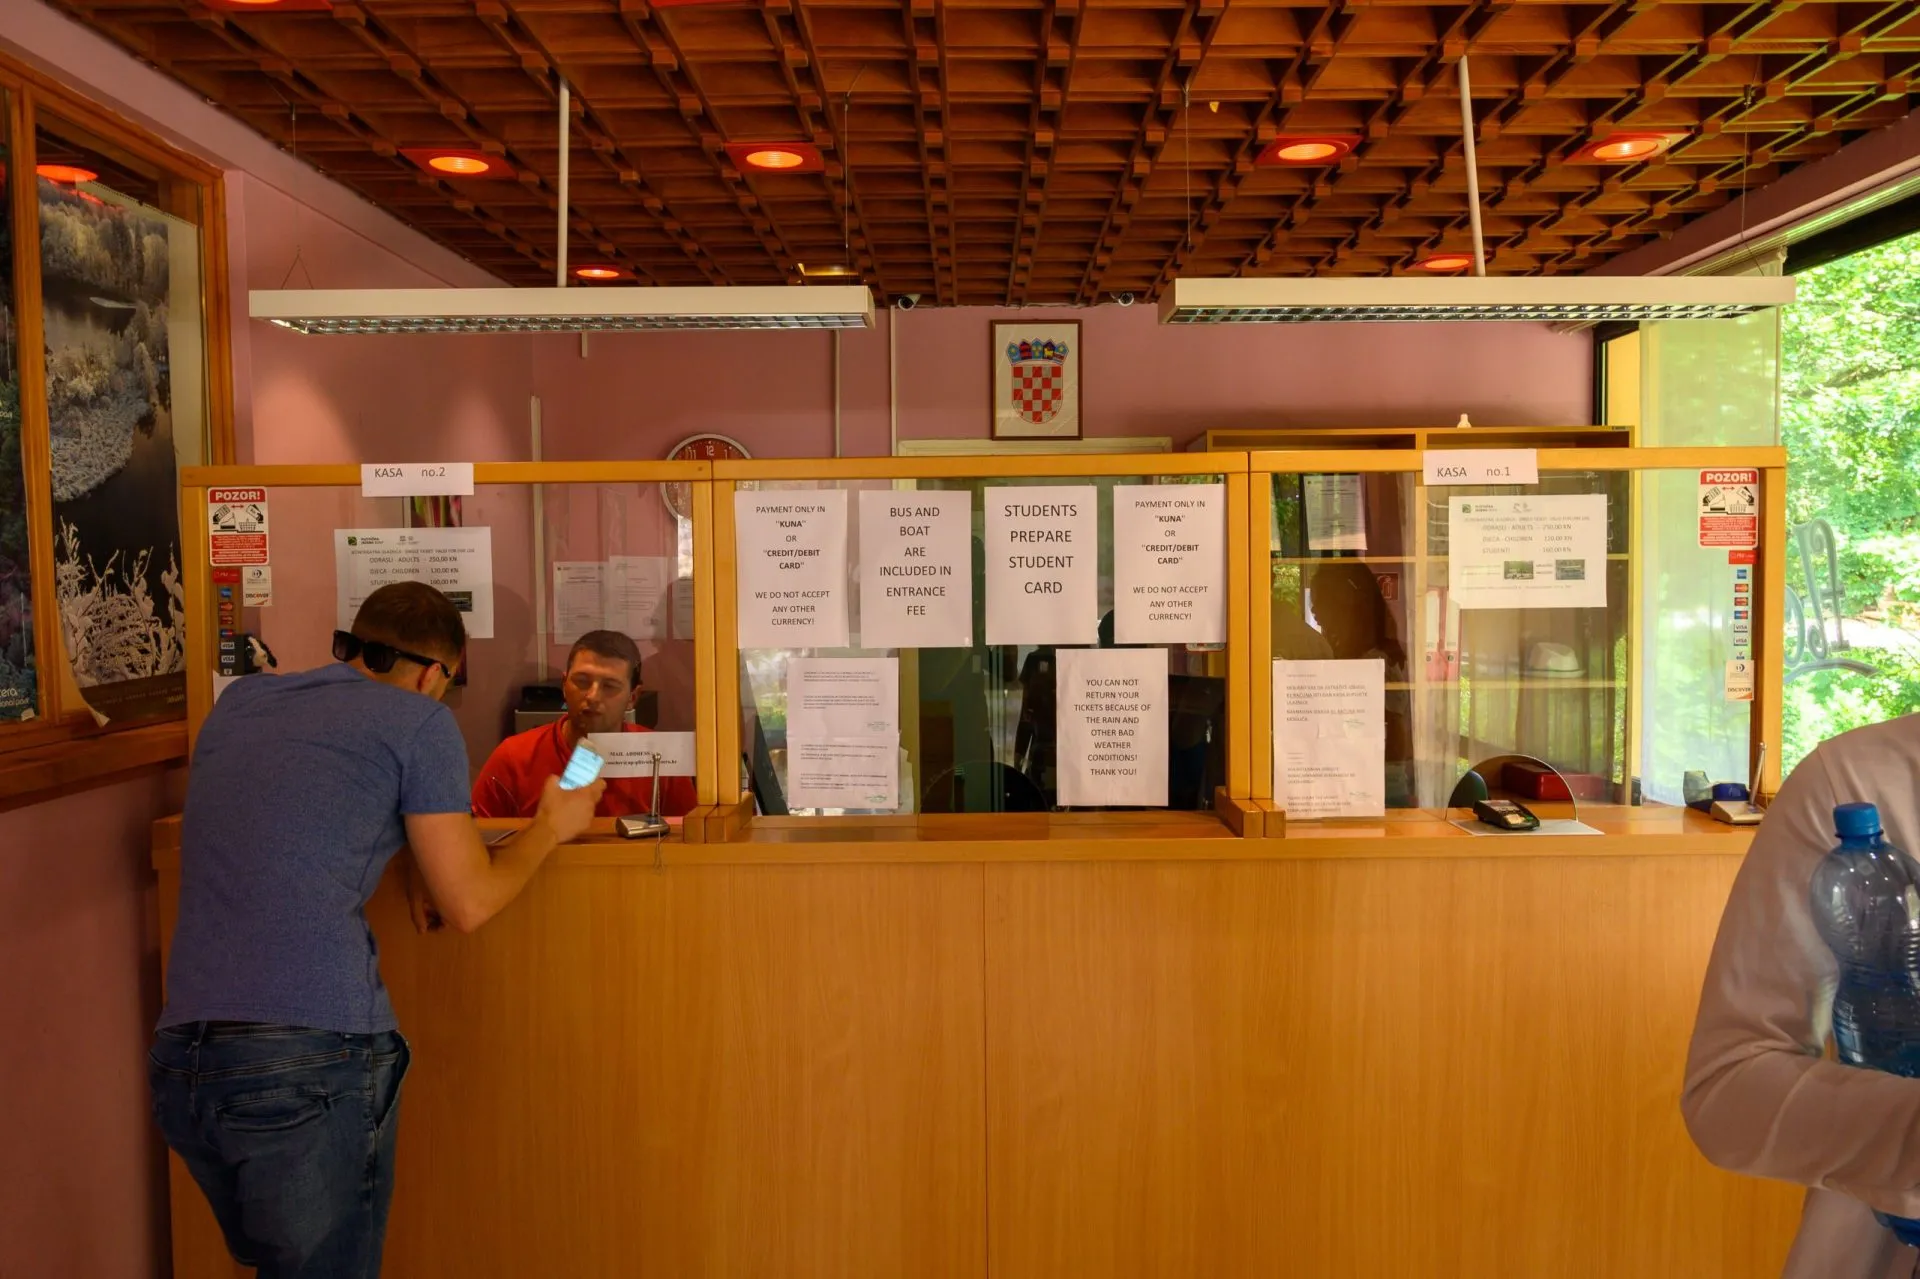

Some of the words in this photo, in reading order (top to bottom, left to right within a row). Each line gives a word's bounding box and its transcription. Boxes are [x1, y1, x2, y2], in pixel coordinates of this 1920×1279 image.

[705, 445, 714, 456] 12
[374, 467, 404, 478] KASA
[421, 466, 446, 478] no.2
[1436, 466, 1468, 478] KASA
[1486, 466, 1511, 477] no.1
[1705, 472, 1753, 483] POZOR!
[215, 490, 261, 501] POZOR!
[1134, 500, 1173, 509] PAYMENT
[1173, 500, 1195, 508] ONLY
[1196, 500, 1206, 508] IN
[755, 505, 793, 514] PAYMENT
[794, 505, 816, 514] ONLY
[816, 505, 826, 513] IN
[889, 507, 912, 518] BUS
[914, 506, 941, 517] AND
[1004, 504, 1078, 518] STUDENTS
[899, 525, 931, 537] BOAT
[1164, 529, 1176, 538] OR
[785, 534, 798, 543] OR
[1010, 530, 1072, 543] PREPARE
[903, 546, 927, 557] ARE
[1008, 555, 1074, 569] STUDENT
[879, 565, 937, 577] INCLUDED
[939, 565, 952, 576] IN
[886, 586, 946, 597] ENTRANCE
[1024, 581, 1063, 594] CARD
[1132, 586, 1146, 594] WE
[1147, 586, 1160, 594] DO
[1160, 585, 1178, 594] NOT
[1178, 585, 1209, 594] ACCEPT
[754, 591, 768, 599] WE
[769, 591, 782, 599] DO
[782, 590, 800, 599] NOT
[801, 590, 831, 599] ACCEPT
[1149, 600, 1166, 608] ANY
[1166, 600, 1193, 608] OTHER
[772, 605, 788, 613] ANY
[789, 605, 816, 613] OTHER
[906, 605, 926, 616] FEE
[1148, 612, 1192, 621] CURRENCY!
[771, 617, 815, 626] CURRENCY!
[1085, 678, 1103, 687] YOU
[1104, 678, 1121, 687] CAN
[1122, 678, 1139, 687] NOT
[1085, 691, 1117, 700] RETURN
[1117, 691, 1140, 699] YOUR
[1073, 703, 1104, 712] TICKETS
[1104, 703, 1139, 712] BECAUSE
[1140, 703, 1152, 712] OF
[1085, 716, 1101, 724] THE
[1102, 716, 1121, 724] RAIN
[1122, 716, 1140, 724] AND
[1090, 728, 1117, 737] OTHER
[1118, 728, 1135, 737] BAD
[1093, 741, 1132, 750] WEATHER
[1087, 753, 1138, 762] CONDITIONS!
[1090, 768, 1117, 776] THANK
[1117, 768, 1137, 776] YOU!
